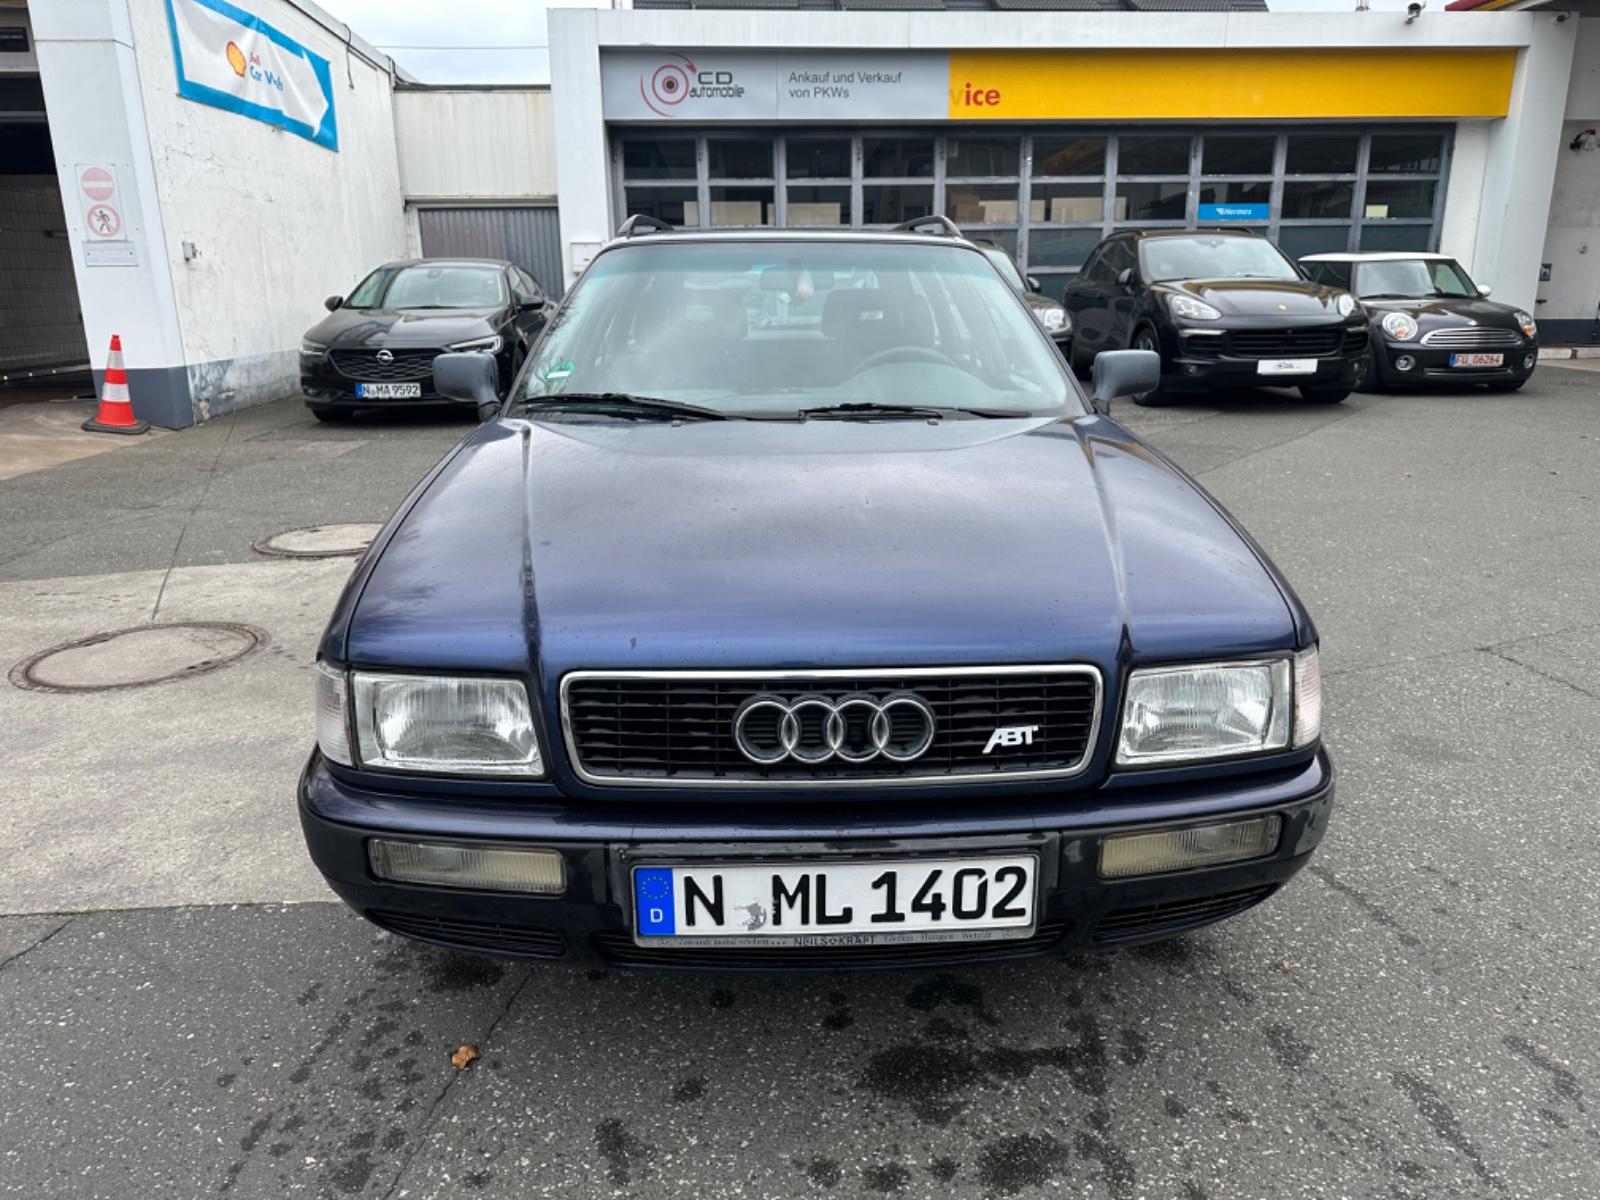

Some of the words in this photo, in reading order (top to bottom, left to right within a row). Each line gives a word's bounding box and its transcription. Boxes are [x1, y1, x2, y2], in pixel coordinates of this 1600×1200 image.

[698, 71, 733, 85] CD
[788, 71, 830, 84] Ankauf
[832, 71, 855, 84] und
[858, 71, 902, 84] Verkauf
[689, 85, 745, 98] automobile
[788, 87, 810, 99] von
[813, 86, 850, 99] PKWs
[363, 384, 371, 395] N
[376, 384, 391, 395] MA
[392, 384, 419, 396] 9592
[982, 725, 1039, 755] ABT
[683, 874, 725, 926] N
[771, 873, 854, 926] ML
[870, 865, 1028, 923] 1402
[650, 908, 664, 923] D
